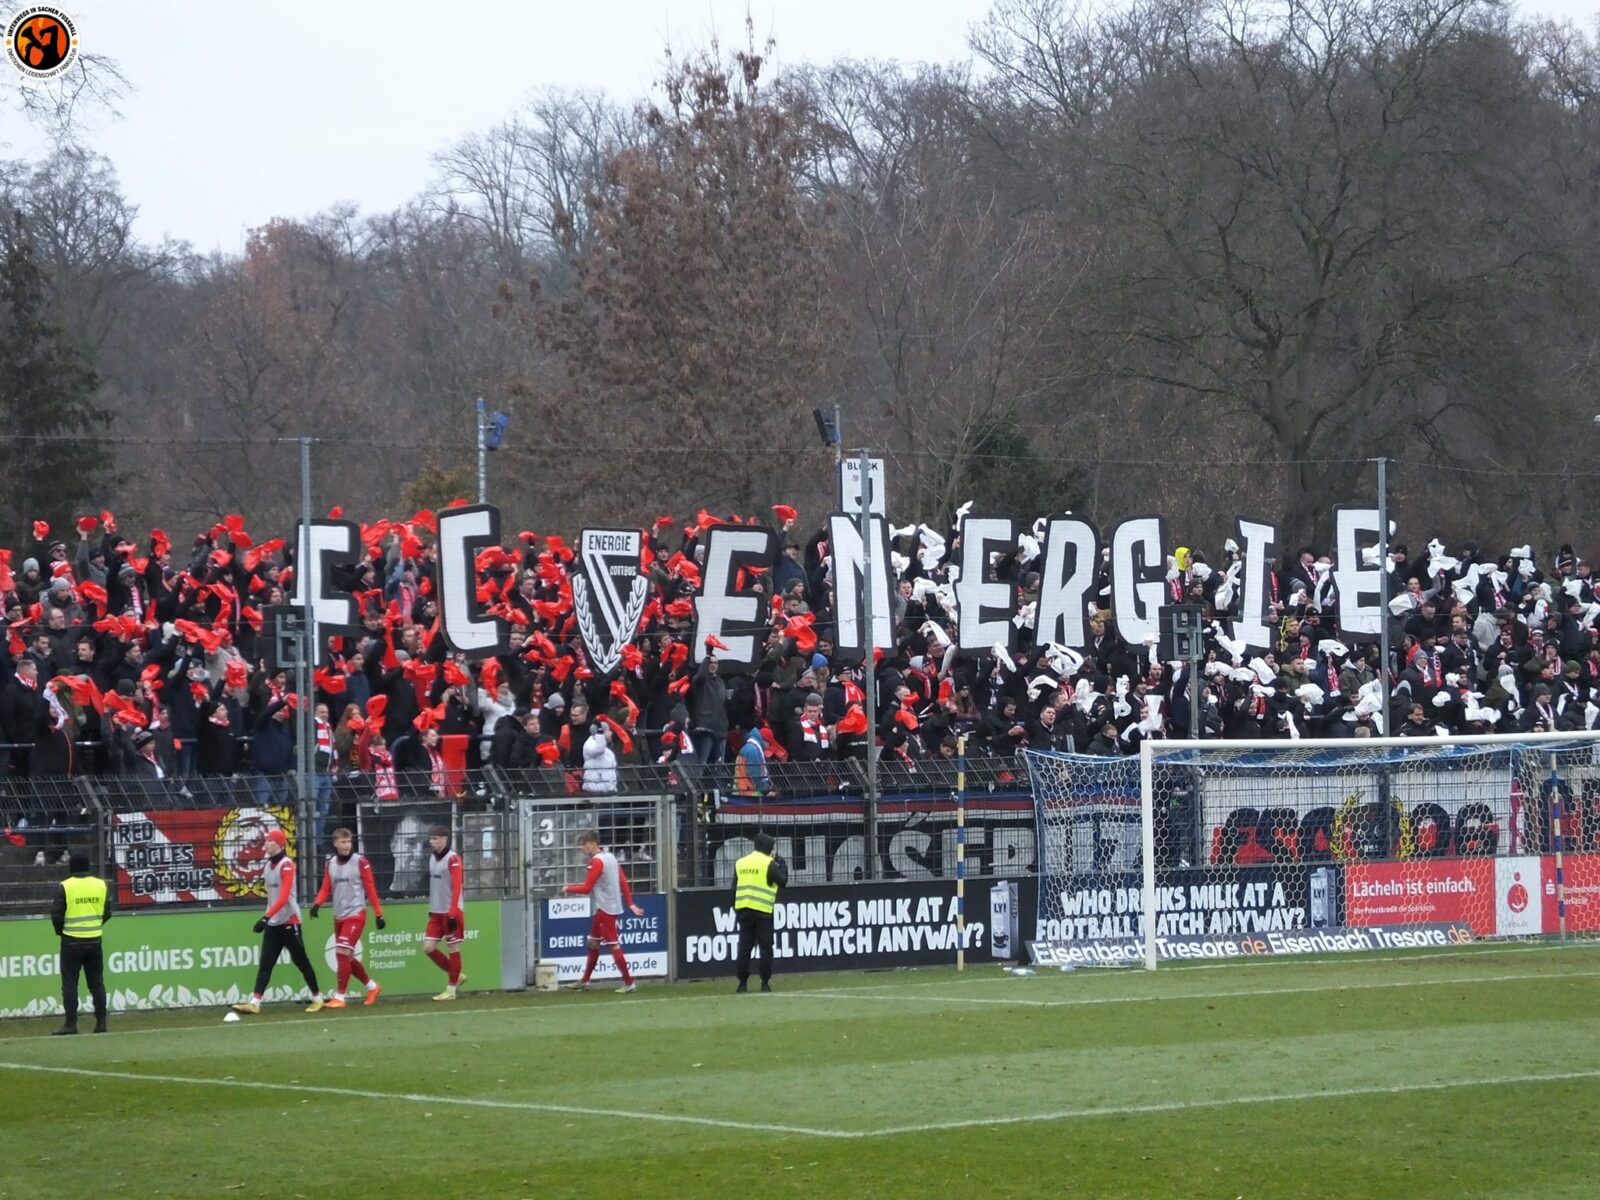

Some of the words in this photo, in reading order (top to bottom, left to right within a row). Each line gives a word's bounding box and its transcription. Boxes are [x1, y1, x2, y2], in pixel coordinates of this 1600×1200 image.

[847, 462, 878, 470] BLCK
[588, 534, 631, 551] ENERGIE
[609, 565, 637, 576] COTTBUS
[118, 821, 155, 845] RED
[540, 818, 554, 846] 3
[126, 844, 194, 869] EAGLES
[133, 869, 213, 895] COTTBUS
[1353, 879, 1403, 897] Lächeln
[1406, 879, 1424, 895] ist
[1426, 876, 1477, 894] einfach.
[75, 897, 99, 905] ORDNER
[563, 903, 585, 913] PCH
[1061, 890, 1111, 915] WHO
[1190, 884, 1239, 909] MILK
[1243, 883, 1268, 907] AT
[1272, 882, 1285, 906] A
[627, 917, 658, 929] STYLE
[773, 901, 851, 930] DRINKS
[857, 898, 911, 925] MILK
[915, 897, 943, 923] AT
[1036, 916, 1134, 941] FOOTBALL
[1210, 908, 1305, 934] ANYWAY?
[369, 930, 412, 945] Energie
[549, 935, 584, 948] DEINE
[686, 932, 793, 963] FOOTLL
[797, 927, 872, 958] MATCH
[878, 922, 984, 953] ANYWAY?
[1267, 929, 1374, 955] Eisenbach
[109, 946, 194, 973] GRÜNES
[369, 948, 416, 958] Stadtwerke
[369, 960, 405, 969] Potsdam
